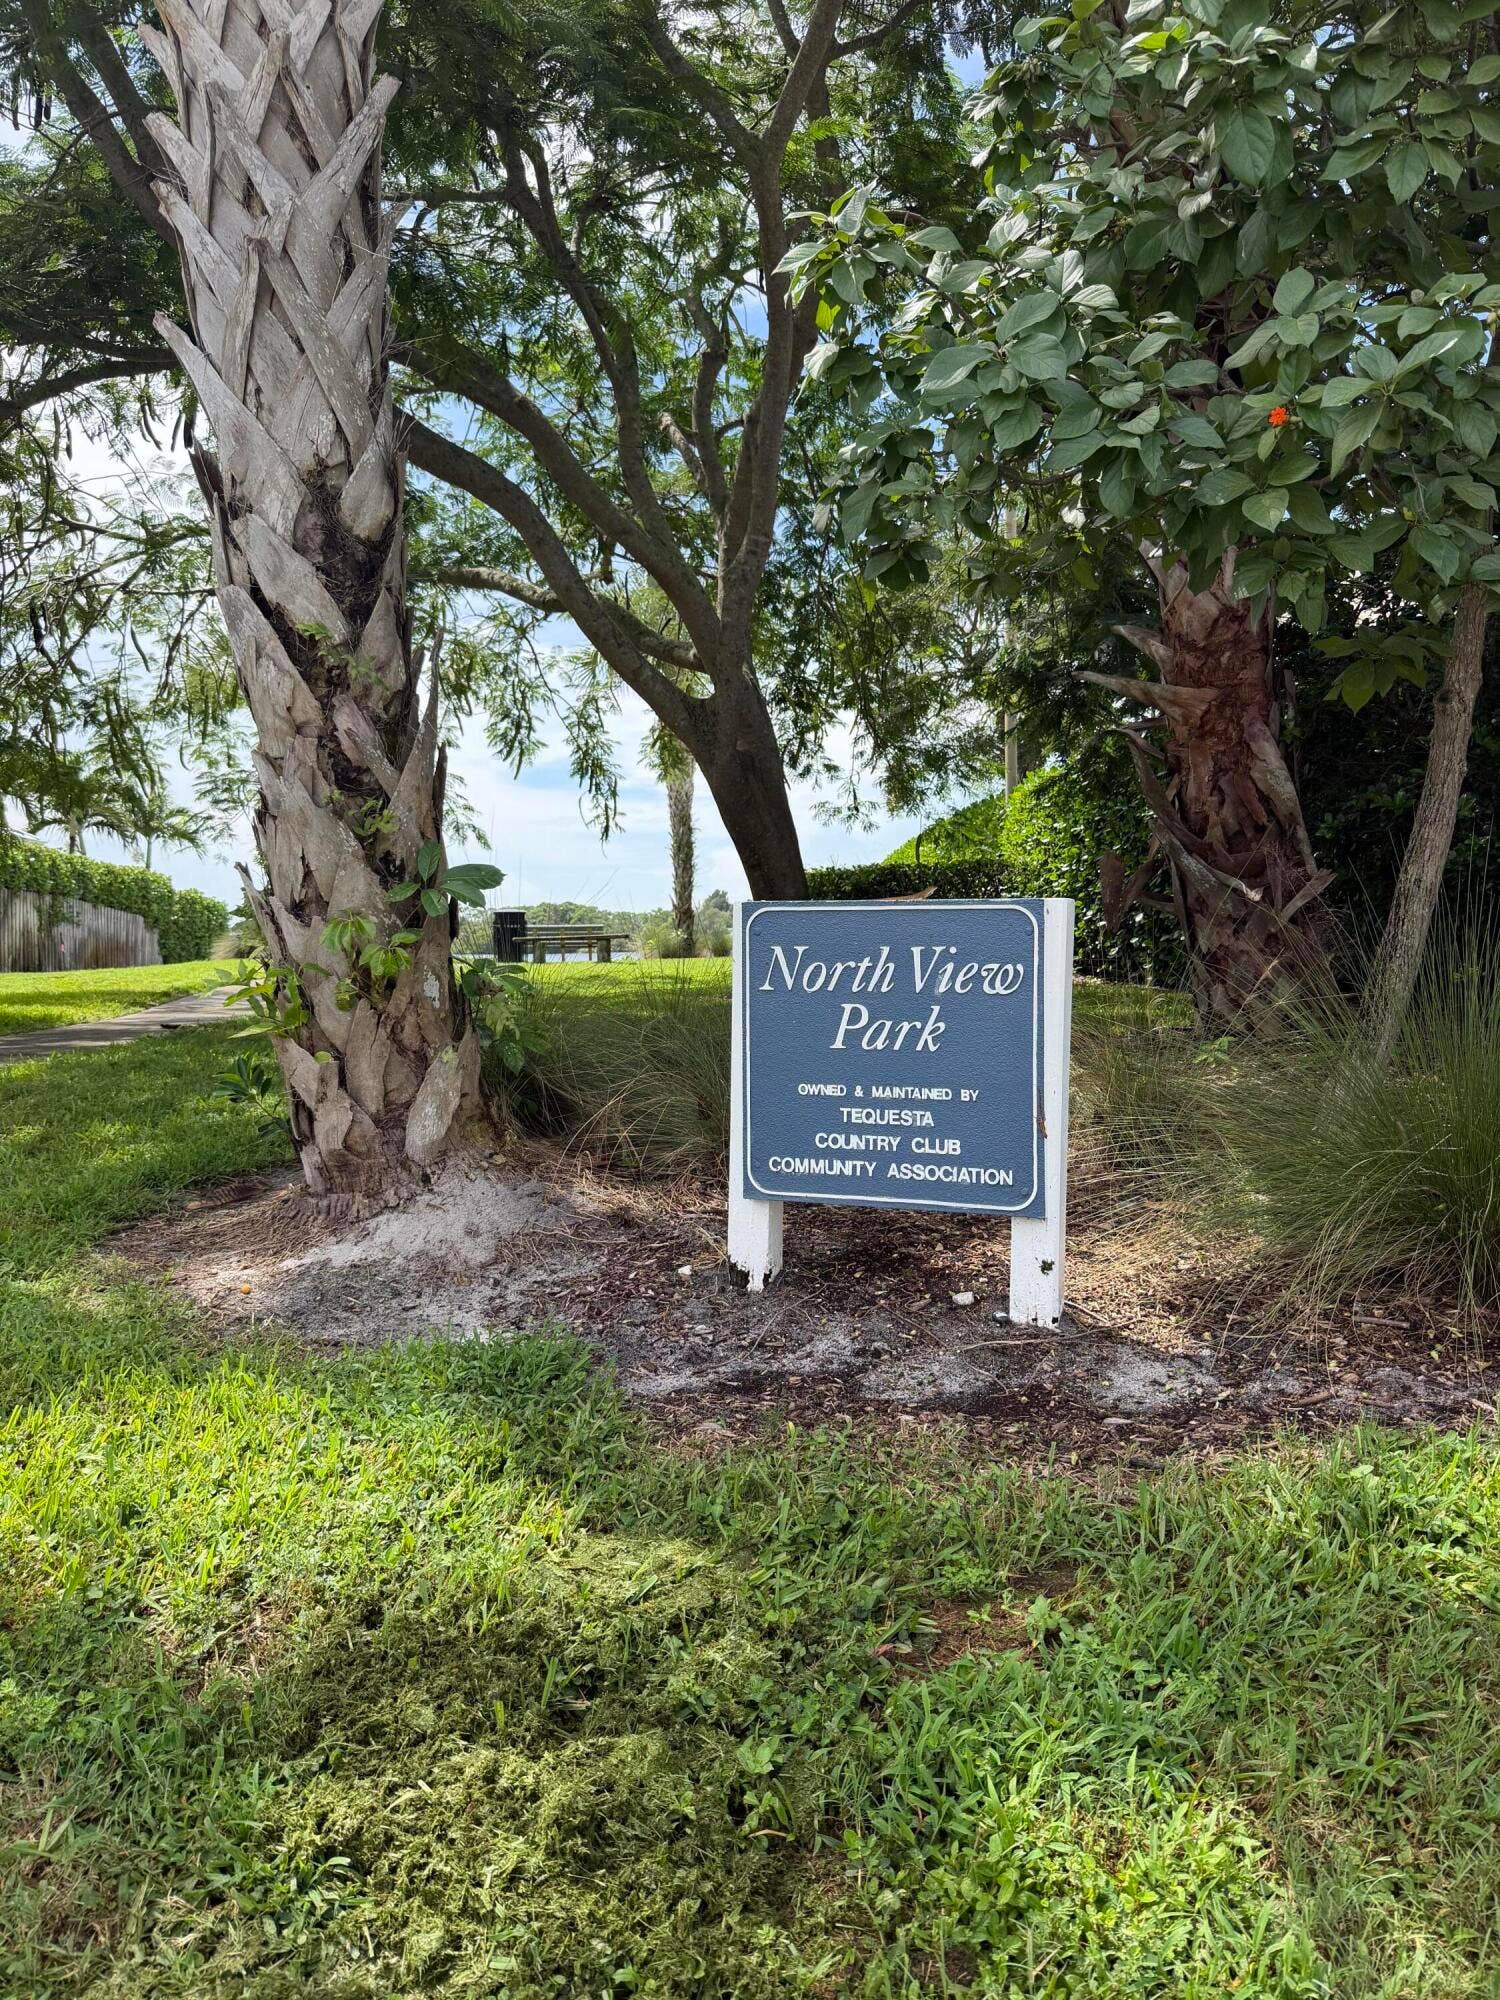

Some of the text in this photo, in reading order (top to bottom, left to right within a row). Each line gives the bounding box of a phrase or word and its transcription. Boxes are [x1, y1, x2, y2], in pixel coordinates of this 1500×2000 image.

[759, 946, 1024, 995] North View
[830, 1003, 946, 1052] Park
[798, 1083, 979, 1102] OWNED & MAINTAINED BY
[840, 1107, 934, 1127] TEQUESTA
[815, 1133, 961, 1156] COUNTRY CLUB
[768, 1156, 1013, 1185] COMMUNITY ASSOCIATION
